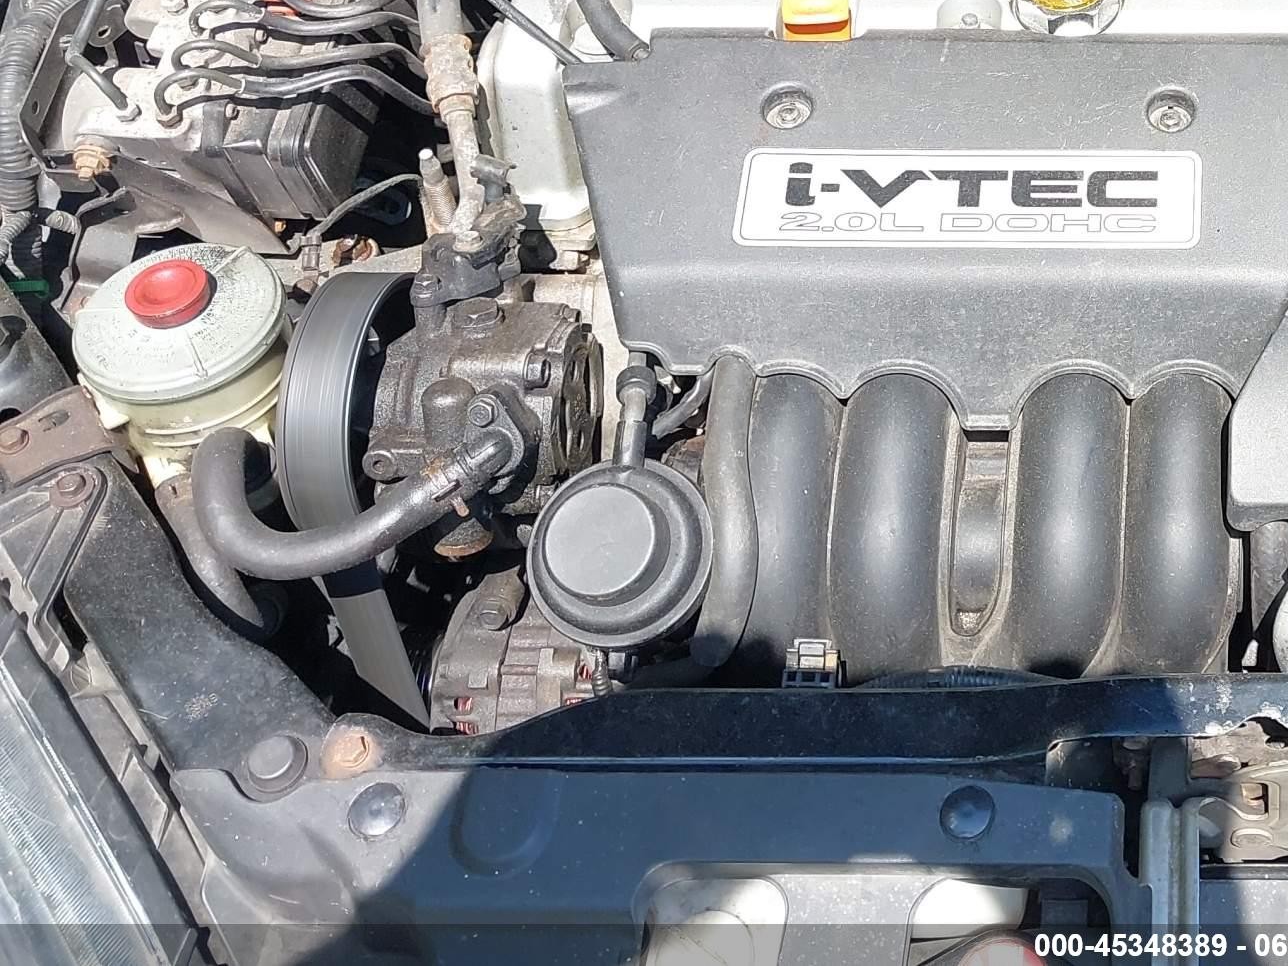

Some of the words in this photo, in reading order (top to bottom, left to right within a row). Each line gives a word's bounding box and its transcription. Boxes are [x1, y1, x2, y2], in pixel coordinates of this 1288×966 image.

[785, 161, 1159, 208] i-VTEC
[778, 212, 924, 232] 2.0L
[939, 212, 1158, 233] DOHC
